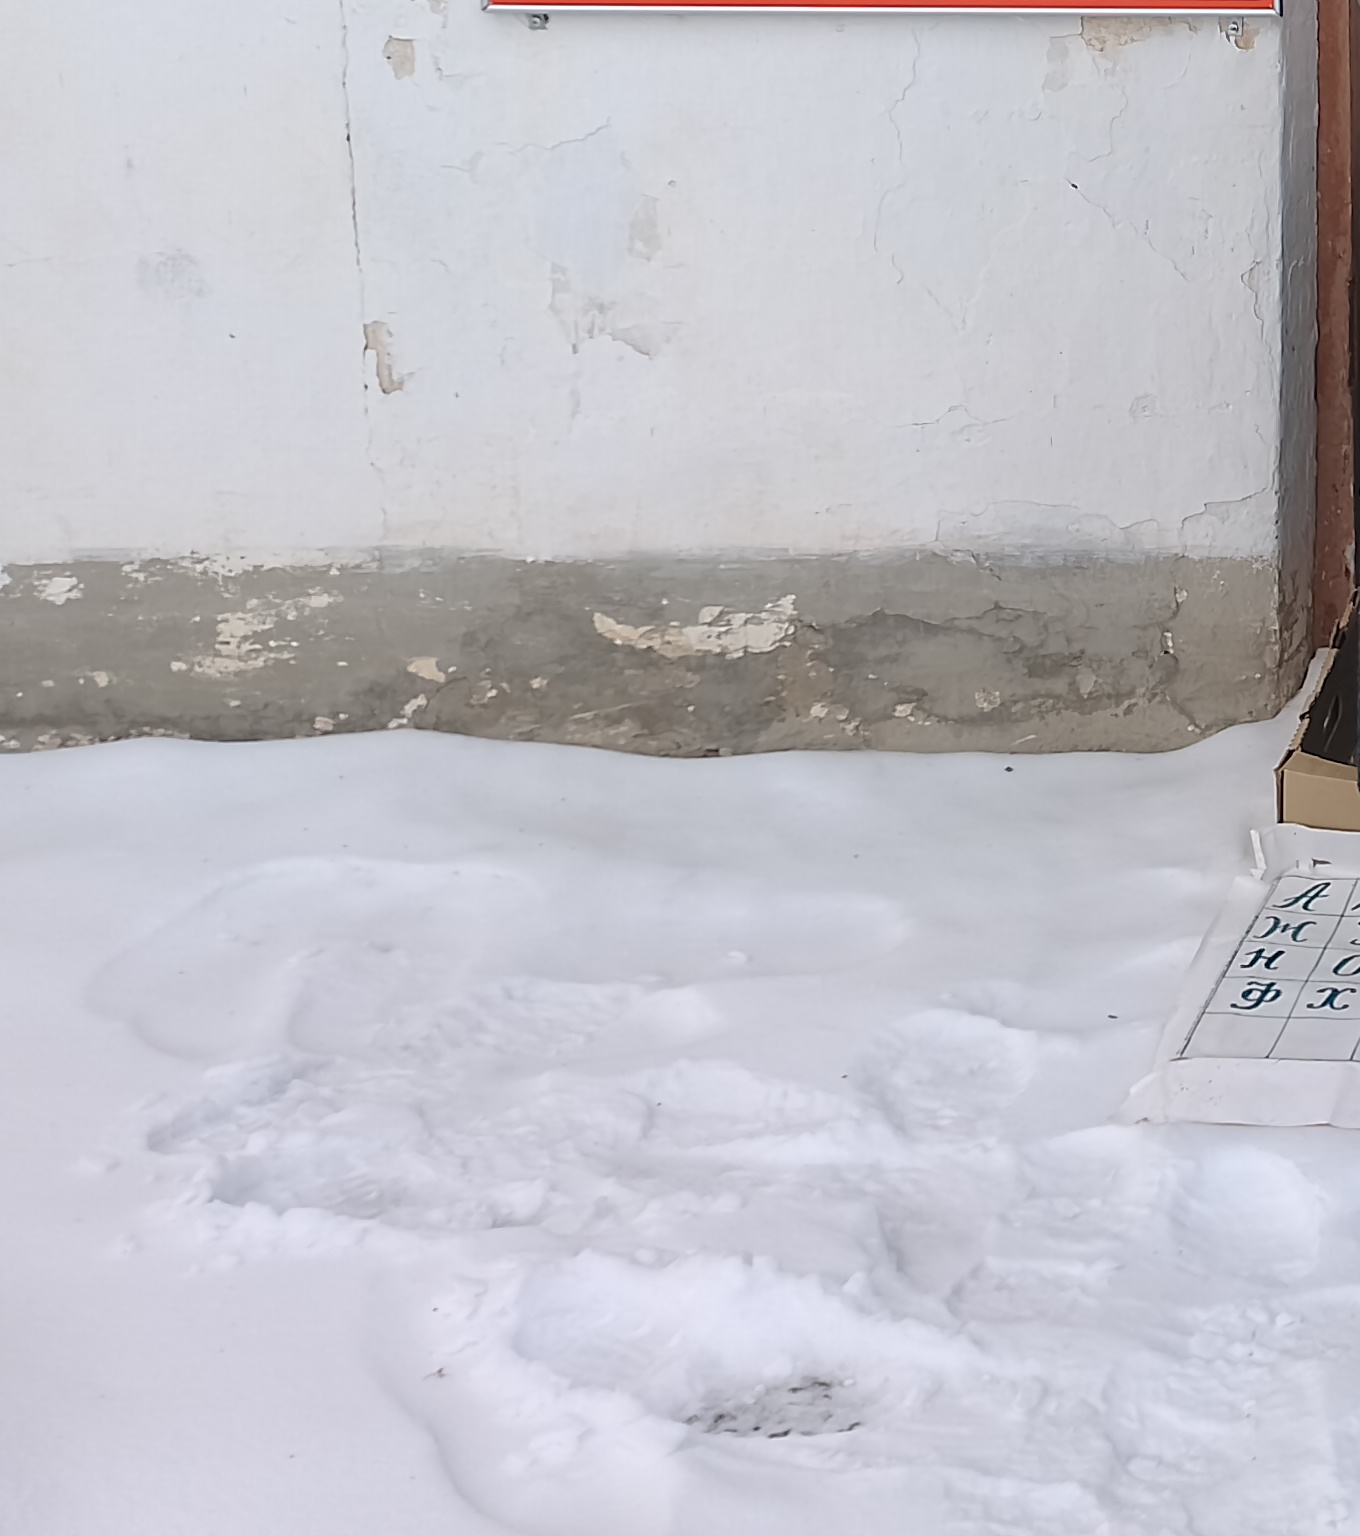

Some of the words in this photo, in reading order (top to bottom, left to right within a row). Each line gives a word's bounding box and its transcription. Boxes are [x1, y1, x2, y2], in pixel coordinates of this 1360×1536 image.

[1272, 881, 1331, 913] А
[1240, 947, 1285, 971] Н
[1230, 980, 1283, 1010] Ф
